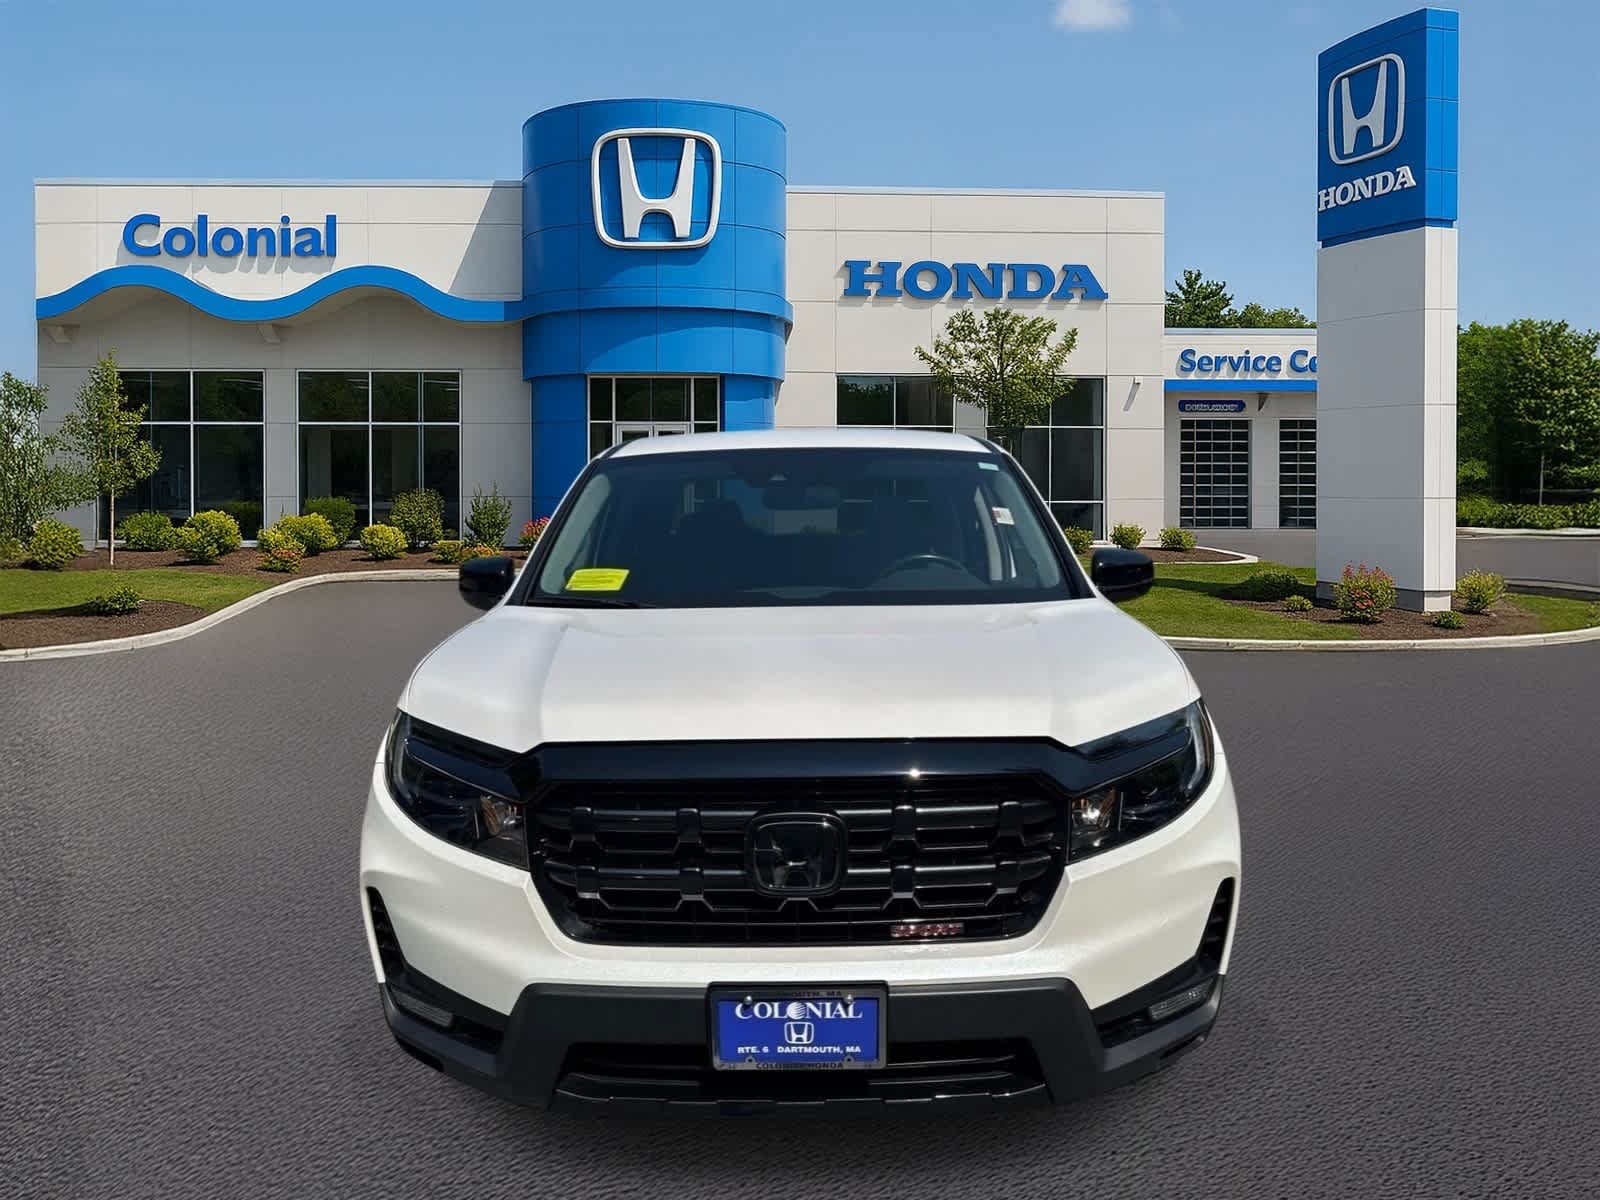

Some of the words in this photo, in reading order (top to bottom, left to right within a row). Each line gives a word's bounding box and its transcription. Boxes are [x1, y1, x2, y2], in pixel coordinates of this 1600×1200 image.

[1318, 165, 1417, 211] HONDA
[122, 213, 337, 257] Colonial
[843, 260, 1109, 300] HONDA
[1180, 348, 1282, 373] Service
[735, 1001, 863, 1020] COLONIAL
[777, 1046, 843, 1054] DARTMOUTH,
